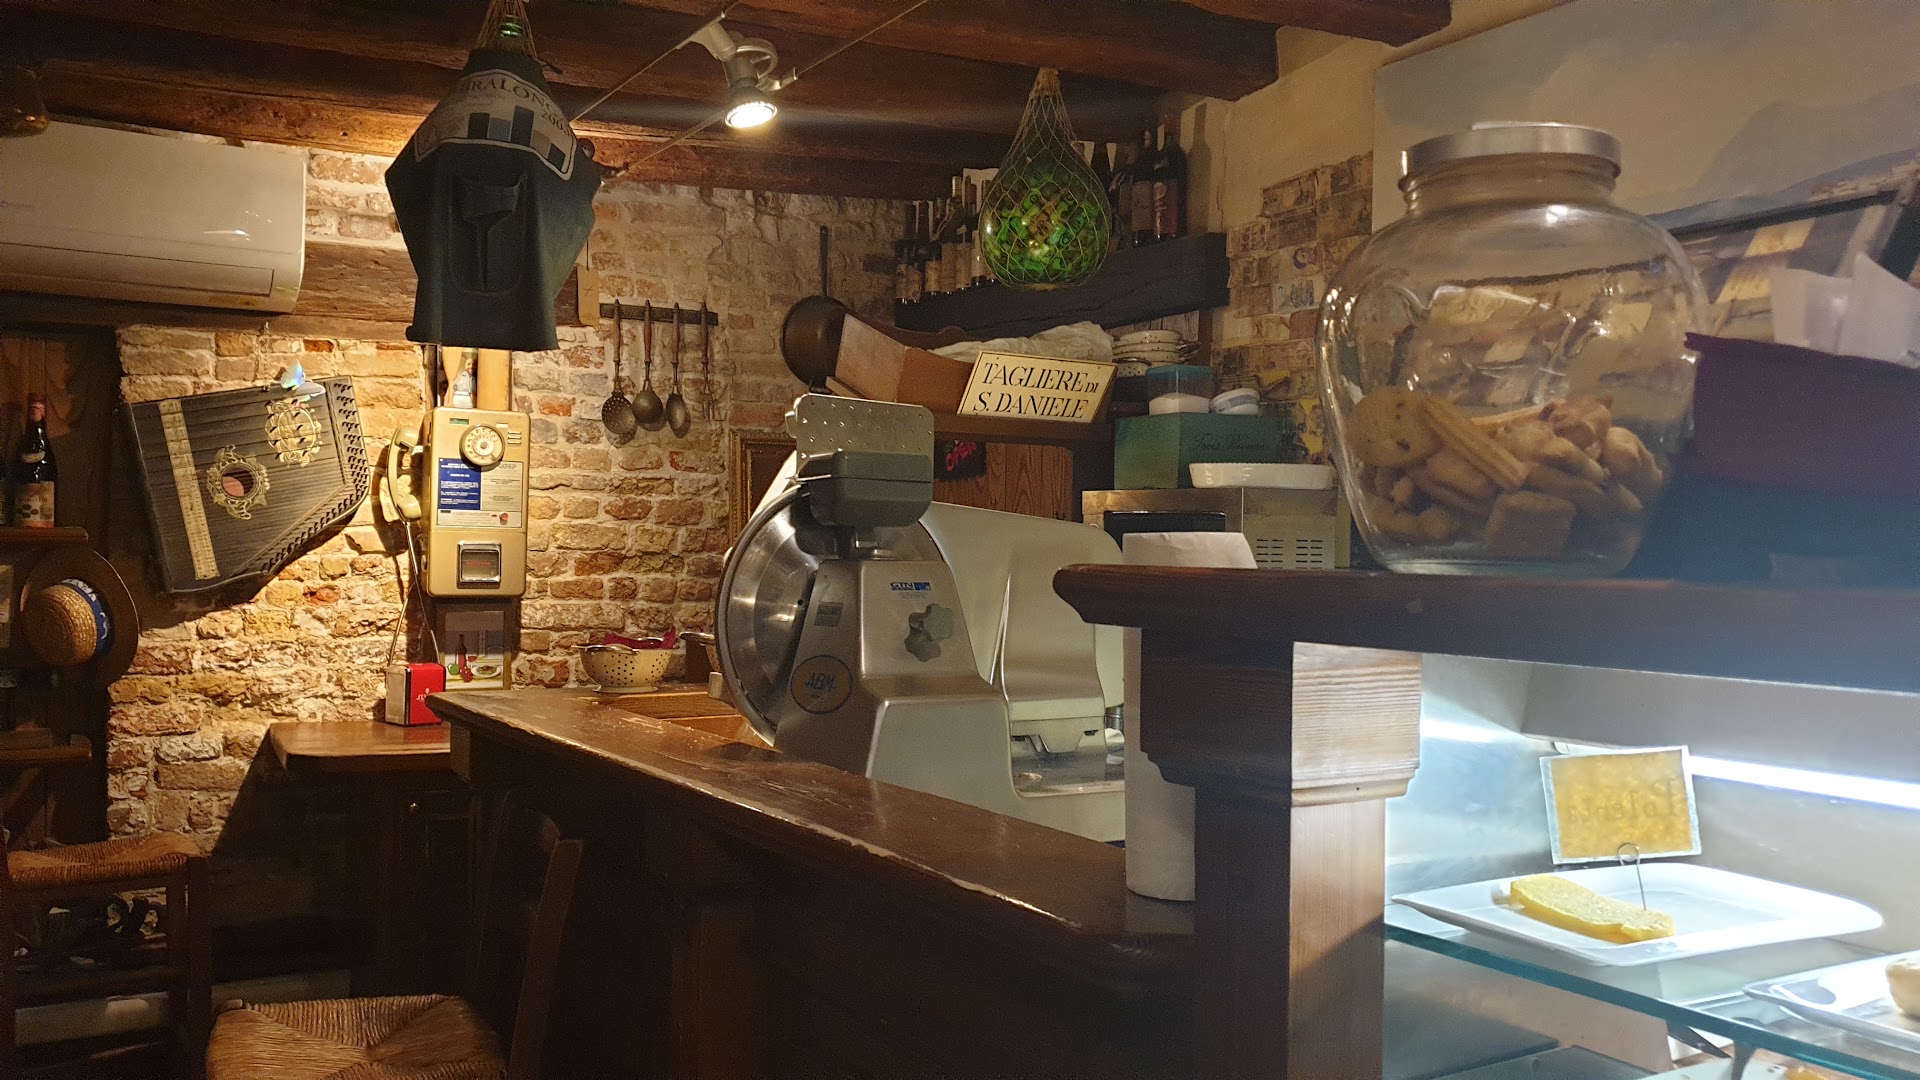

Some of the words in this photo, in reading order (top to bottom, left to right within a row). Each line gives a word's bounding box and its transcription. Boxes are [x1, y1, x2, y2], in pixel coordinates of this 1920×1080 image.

[982, 362, 1088, 393] TAGLIERE
[1084, 382, 1100, 394] DI
[972, 391, 992, 412] S.
[994, 393, 1089, 419] DANIELE
